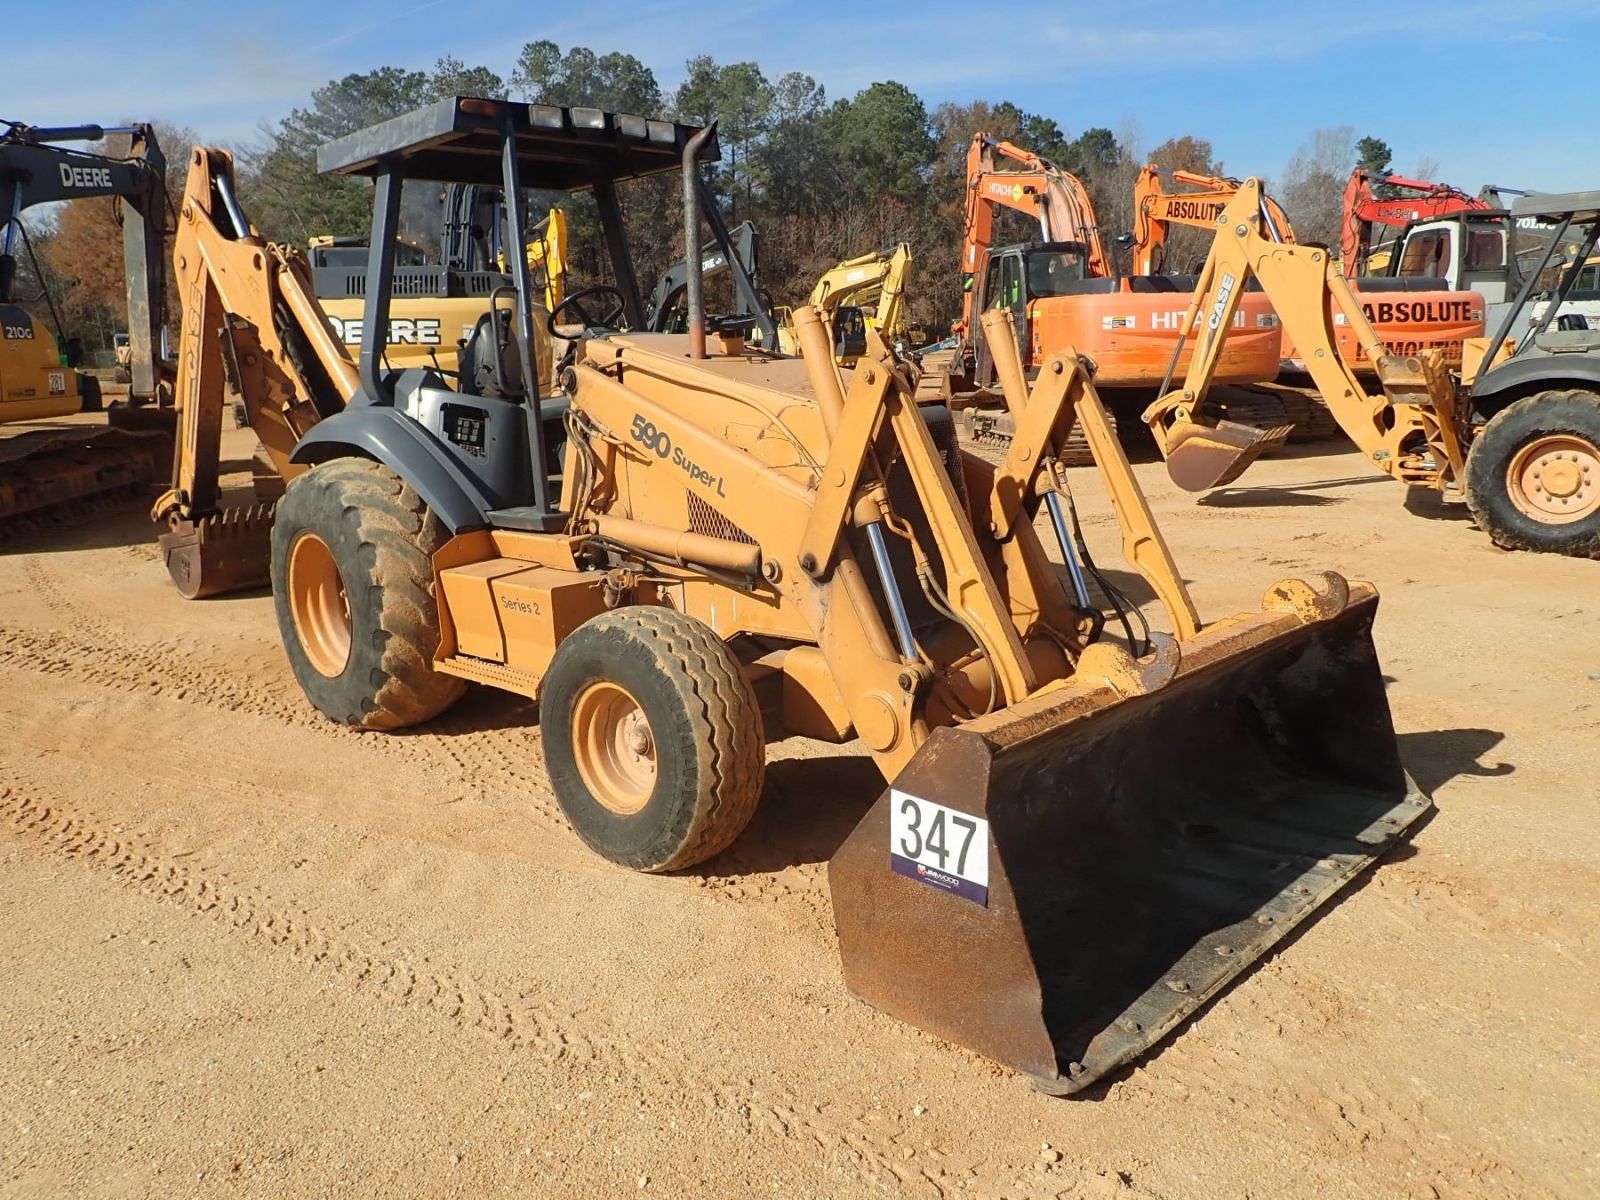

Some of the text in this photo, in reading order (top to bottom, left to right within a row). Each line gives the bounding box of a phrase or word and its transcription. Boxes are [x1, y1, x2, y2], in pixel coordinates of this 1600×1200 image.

[59, 162, 113, 188] DEERE
[1208, 272, 1235, 330] CASE
[1362, 301, 1472, 323] ABSOLUTE
[5, 326, 33, 339] 210G
[327, 315, 442, 345] DERE
[630, 413, 726, 499] 590 Super L
[501, 596, 541, 615] Series 2
[900, 799, 977, 876] 347
